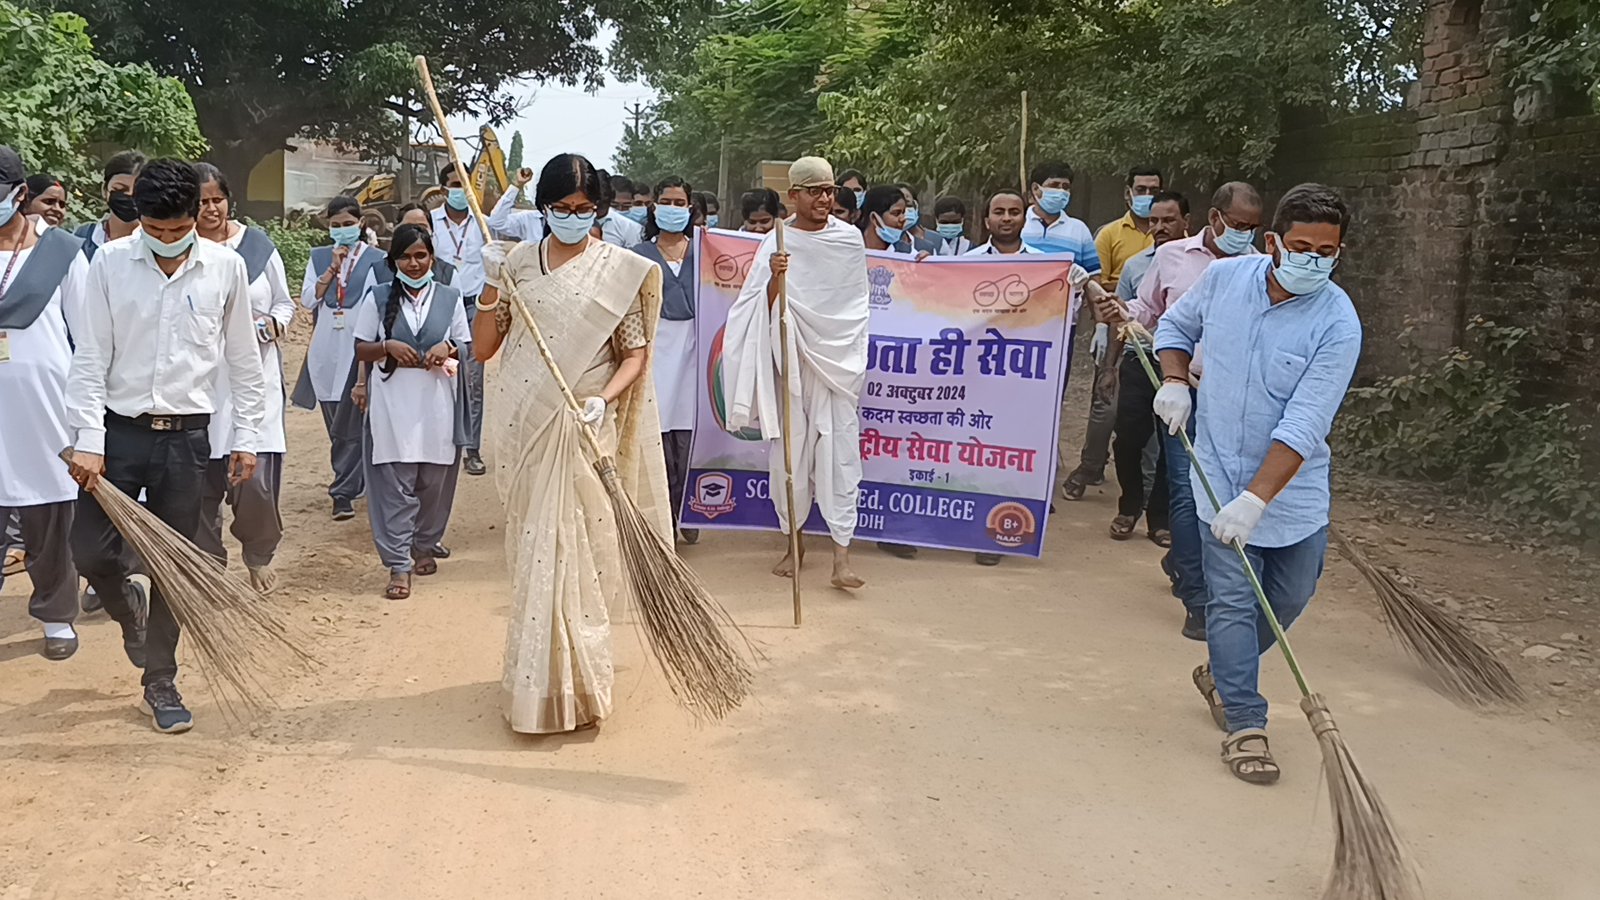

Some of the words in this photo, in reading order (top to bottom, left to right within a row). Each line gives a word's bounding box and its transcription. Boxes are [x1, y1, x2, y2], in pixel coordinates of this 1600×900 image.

[929, 328, 971, 375] ही
[977, 328, 1052, 379] सेवा
[867, 381, 882, 397] 02
[936, 385, 966, 400] 2024
[862, 406, 895, 423] कदम
[898, 410, 943, 425] स्वच्छता
[946, 407, 965, 427] की
[968, 409, 993, 430] ओर
[859, 428, 902, 460] ट्रीय
[906, 431, 953, 463] सेवा
[957, 436, 1036, 472] योजना
[909, 469, 935, 483] इकाई
[945, 473, 949, 483] 1
[745, 478, 772, 499] SC
[857, 488, 884, 511] Ed.
[889, 492, 975, 521] COLLEGE
[859, 513, 885, 530] DIH
[1003, 518, 1019, 529] B+
[996, 534, 1021, 543] NAAC
